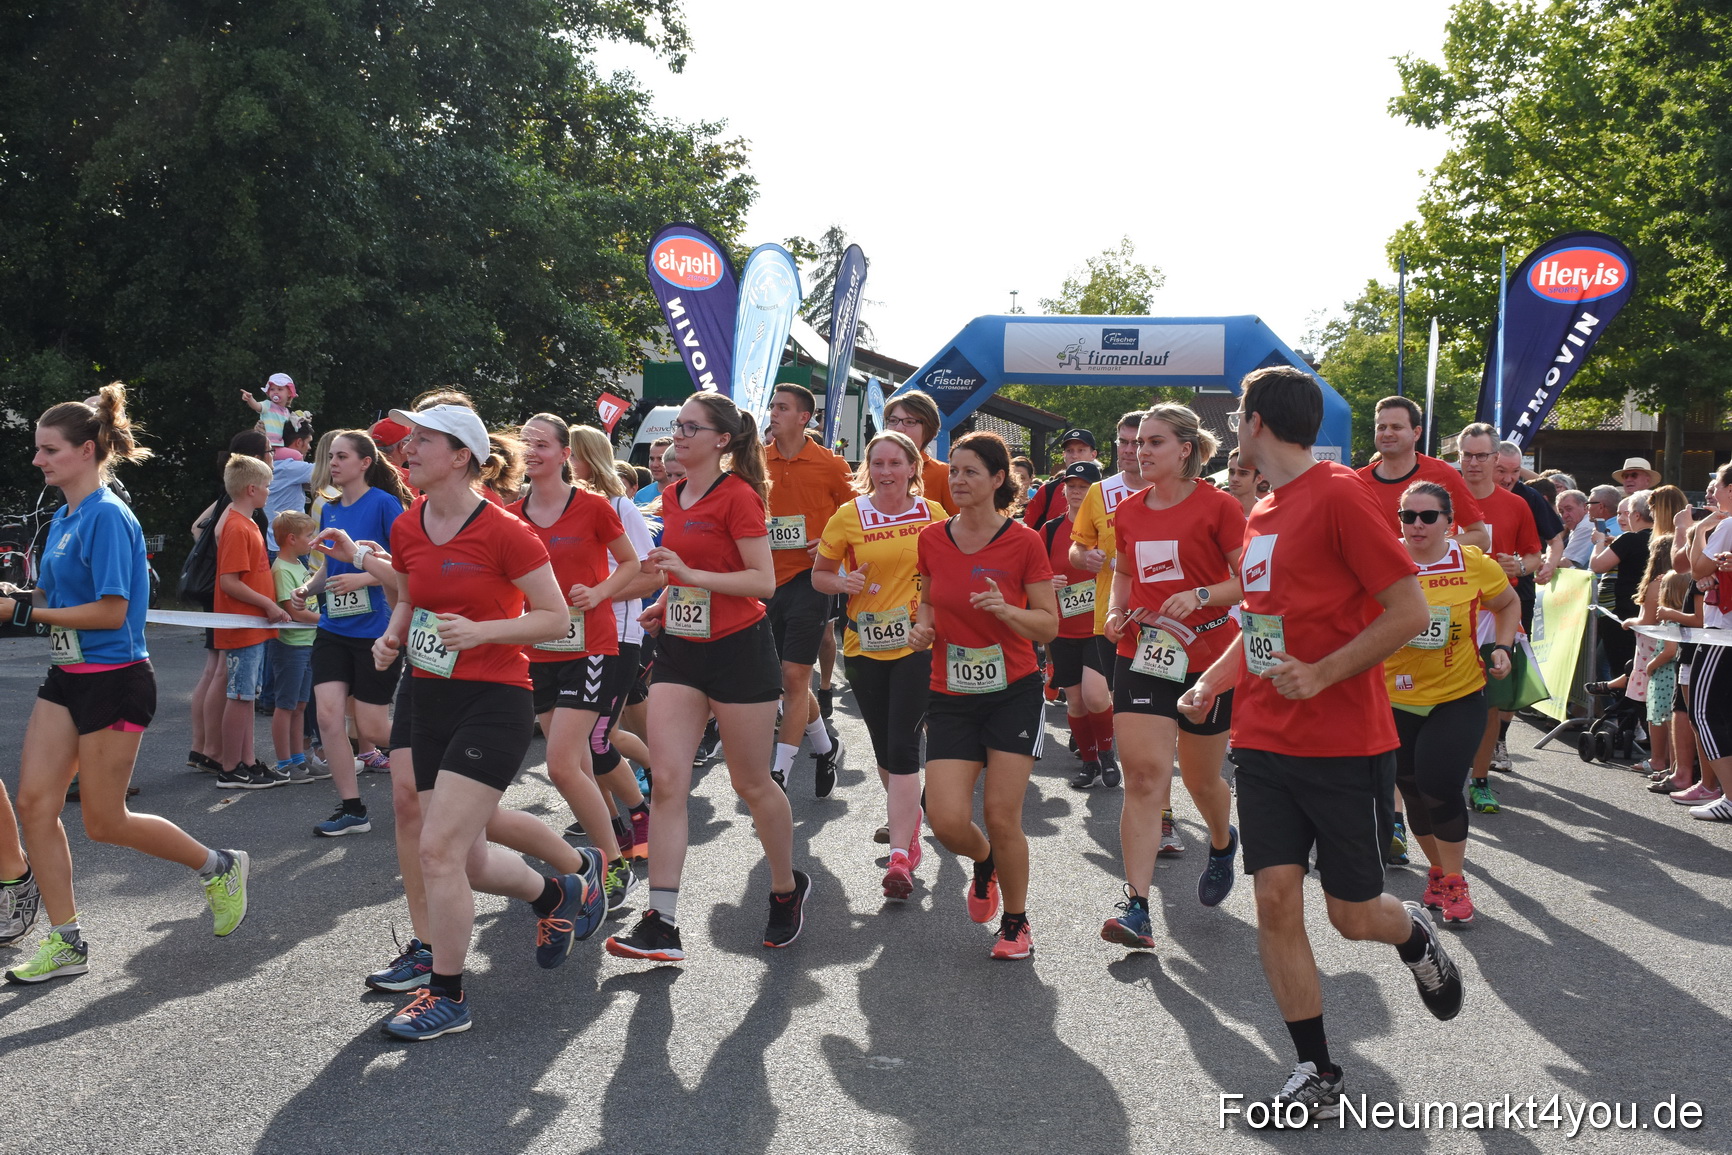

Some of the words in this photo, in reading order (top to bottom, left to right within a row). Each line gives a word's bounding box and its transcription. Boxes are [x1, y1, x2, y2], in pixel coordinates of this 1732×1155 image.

[1538, 261, 1619, 291] Hervis
[1548, 286, 1579, 294] SPORTS
[1088, 350, 1170, 366] firmenlauf
[933, 375, 976, 385] Fischer
[769, 527, 800, 541] 1803
[863, 530, 895, 543] MAX
[1428, 575, 1468, 588] BÖGL
[334, 591, 358, 607] 573
[1063, 591, 1095, 609] 2342
[670, 603, 702, 624] 1032
[864, 622, 905, 640] 1648
[411, 628, 448, 659] 1034
[1249, 635, 1273, 661] 489
[1143, 644, 1176, 666] 545
[952, 662, 997, 681] 1030
